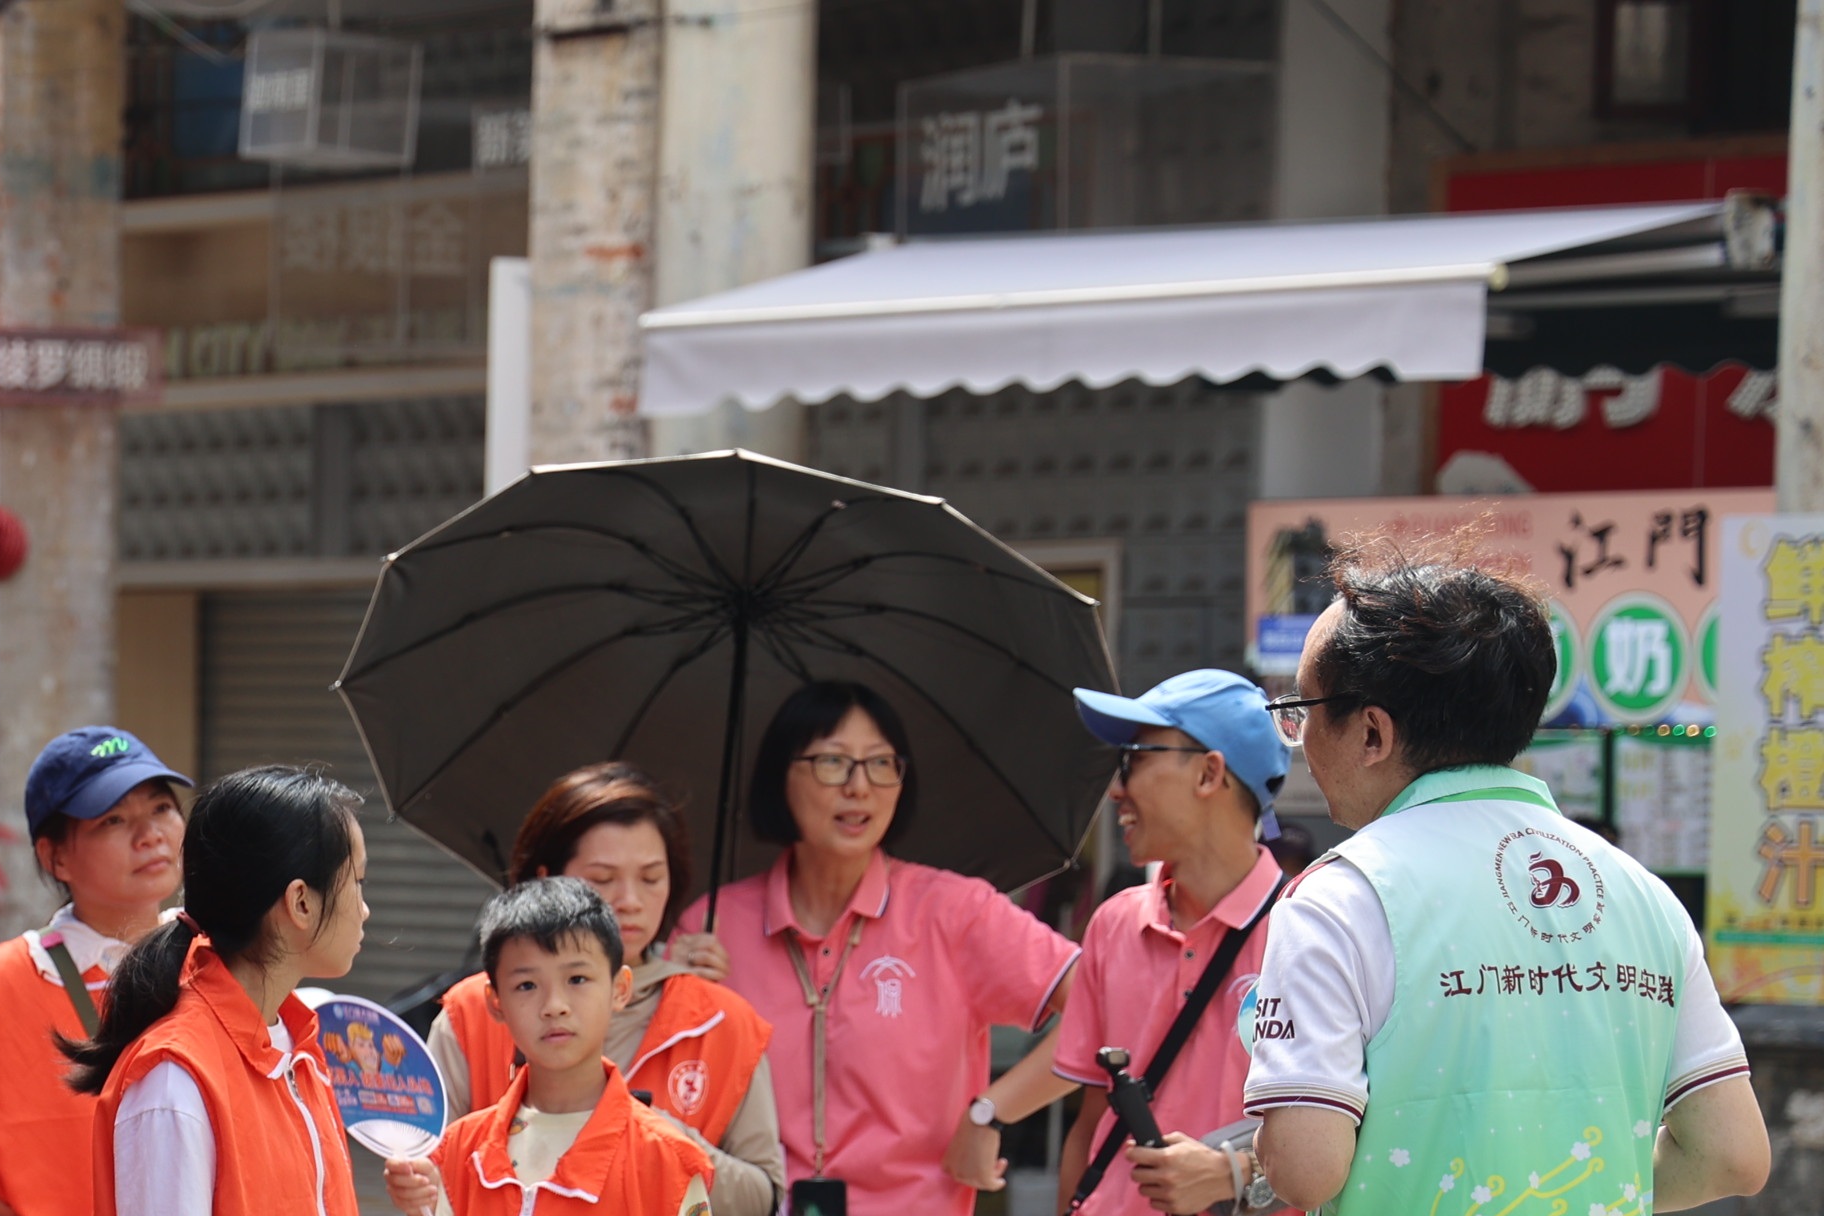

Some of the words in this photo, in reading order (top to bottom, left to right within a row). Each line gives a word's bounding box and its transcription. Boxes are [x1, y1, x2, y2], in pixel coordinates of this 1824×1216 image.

[1556, 503, 1710, 588] 江門
[1439, 961, 1675, 1008] 江门新时代文明实践
[1252, 1019, 1296, 1043] NDA
